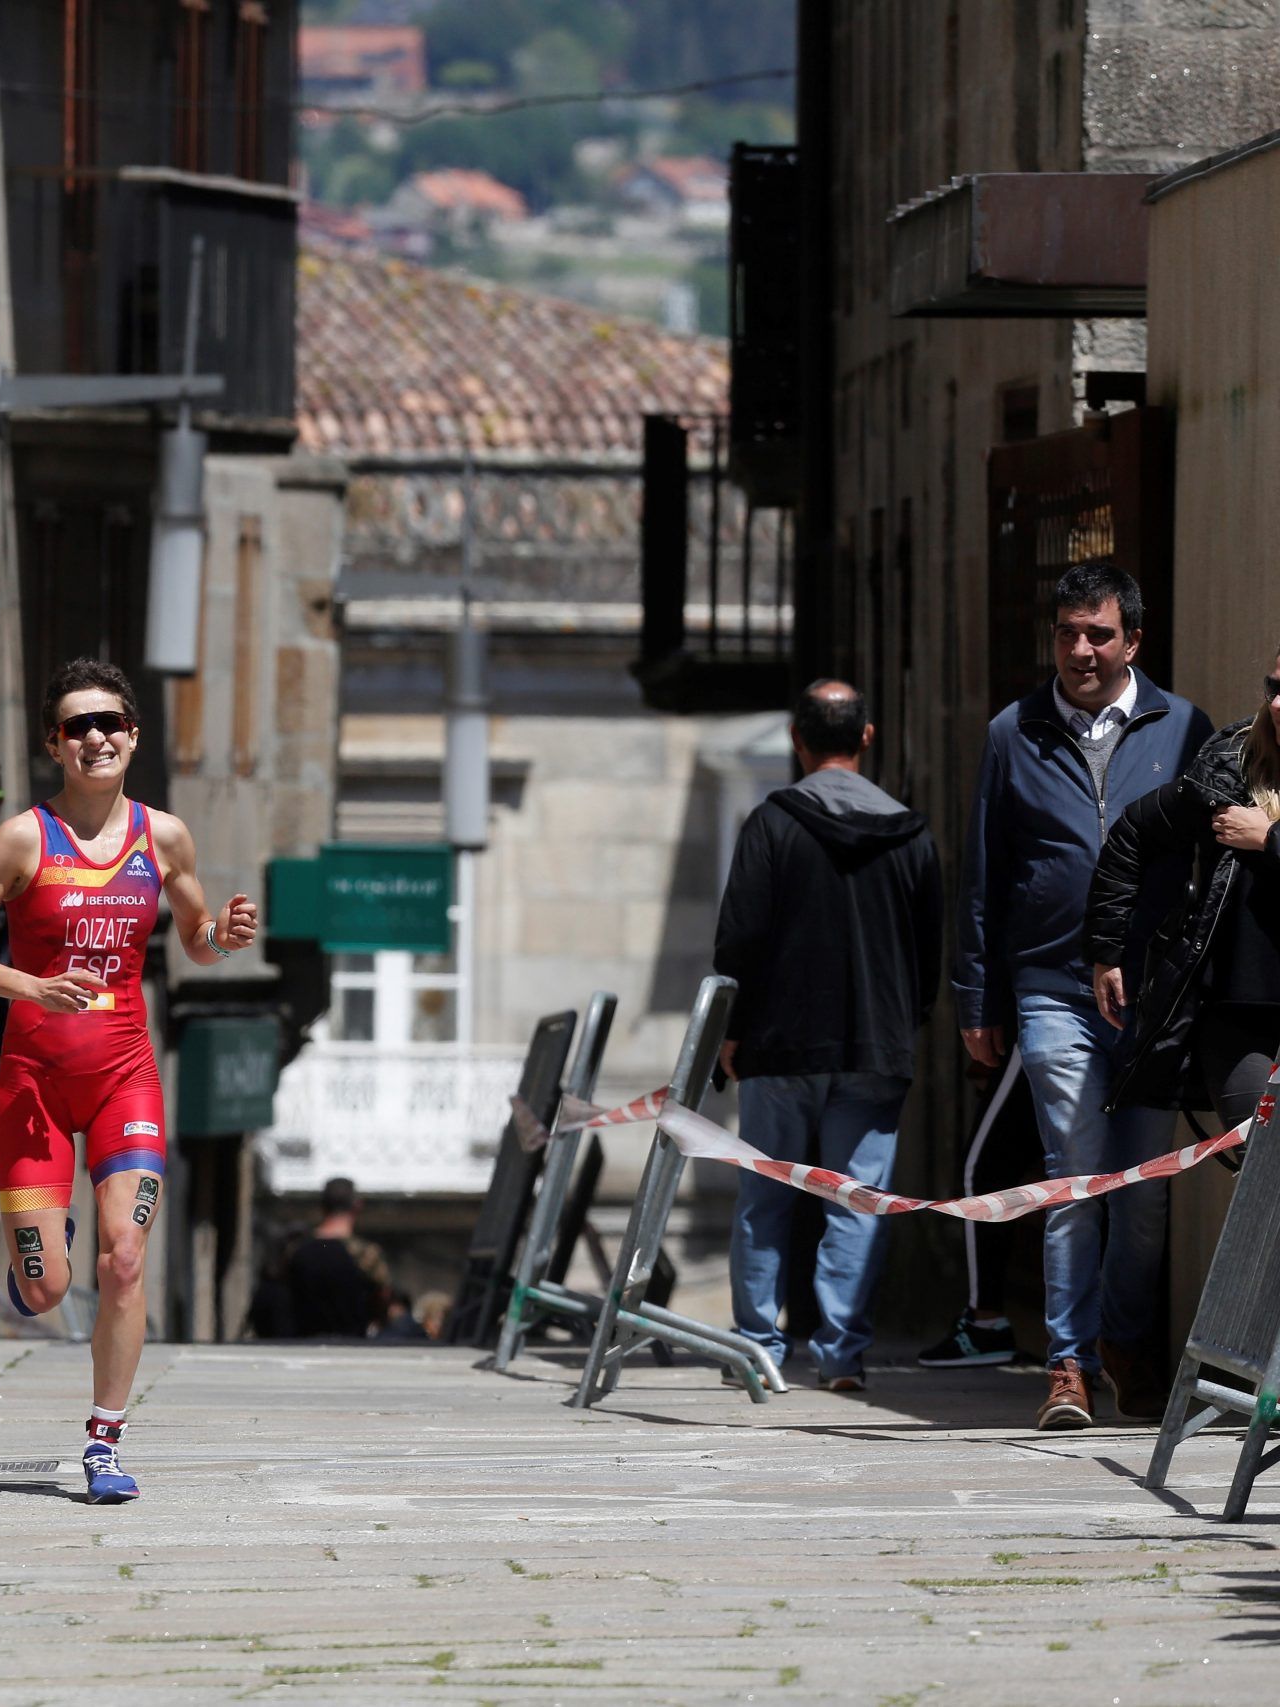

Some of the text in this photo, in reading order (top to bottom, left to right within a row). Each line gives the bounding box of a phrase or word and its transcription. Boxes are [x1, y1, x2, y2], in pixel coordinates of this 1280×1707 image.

[86, 895, 146, 906] IBERDROLA
[64, 917, 138, 949] LOIZATE
[131, 1203, 151, 1226] 6
[23, 1255, 45, 1280] 6
